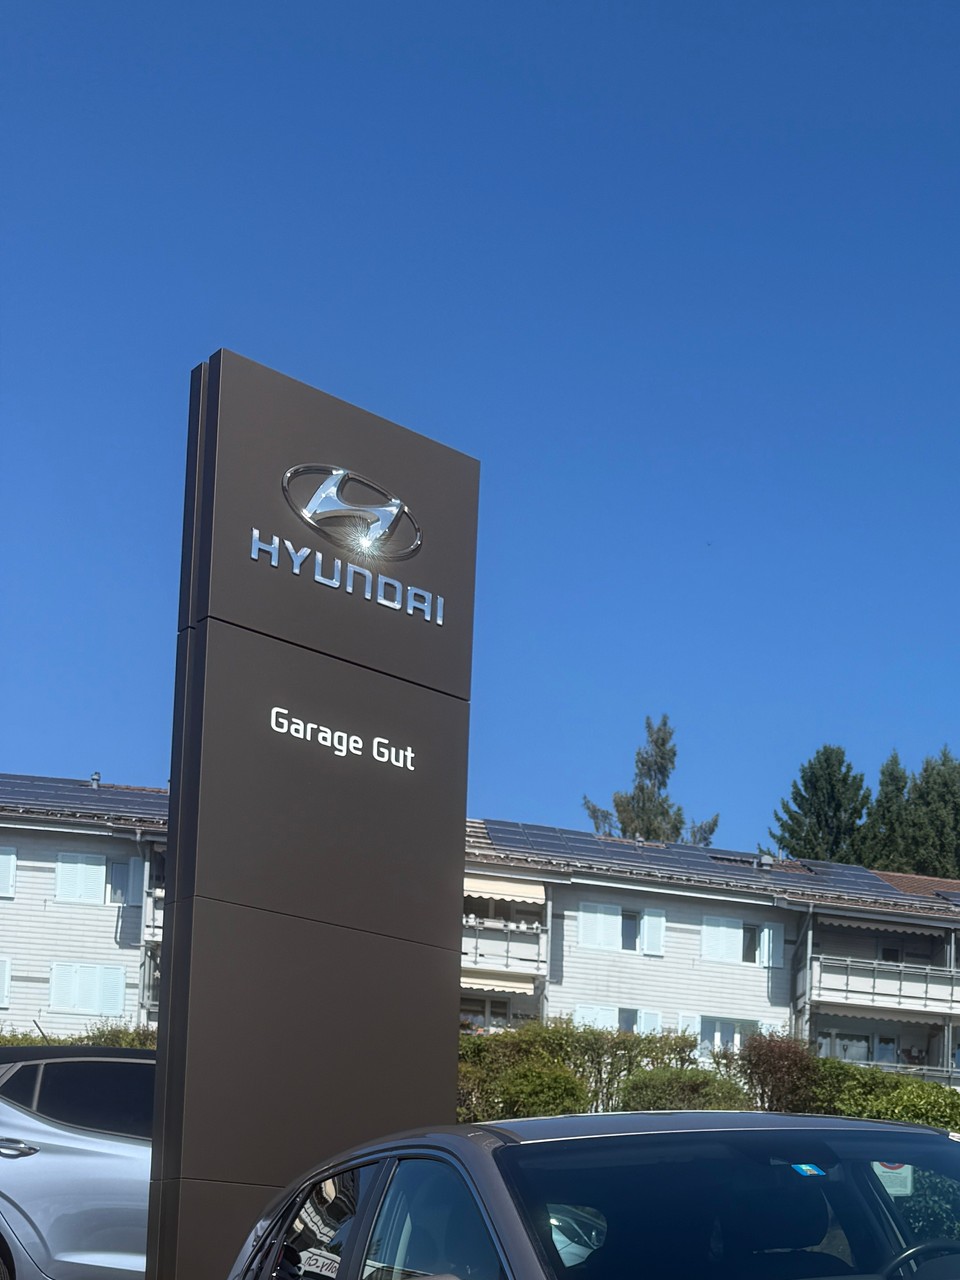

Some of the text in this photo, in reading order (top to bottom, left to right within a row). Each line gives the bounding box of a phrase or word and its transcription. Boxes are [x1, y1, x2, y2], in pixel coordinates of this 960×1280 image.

[250, 527, 445, 626] HYUNDAI
[270, 707, 415, 771] Garage Gut
